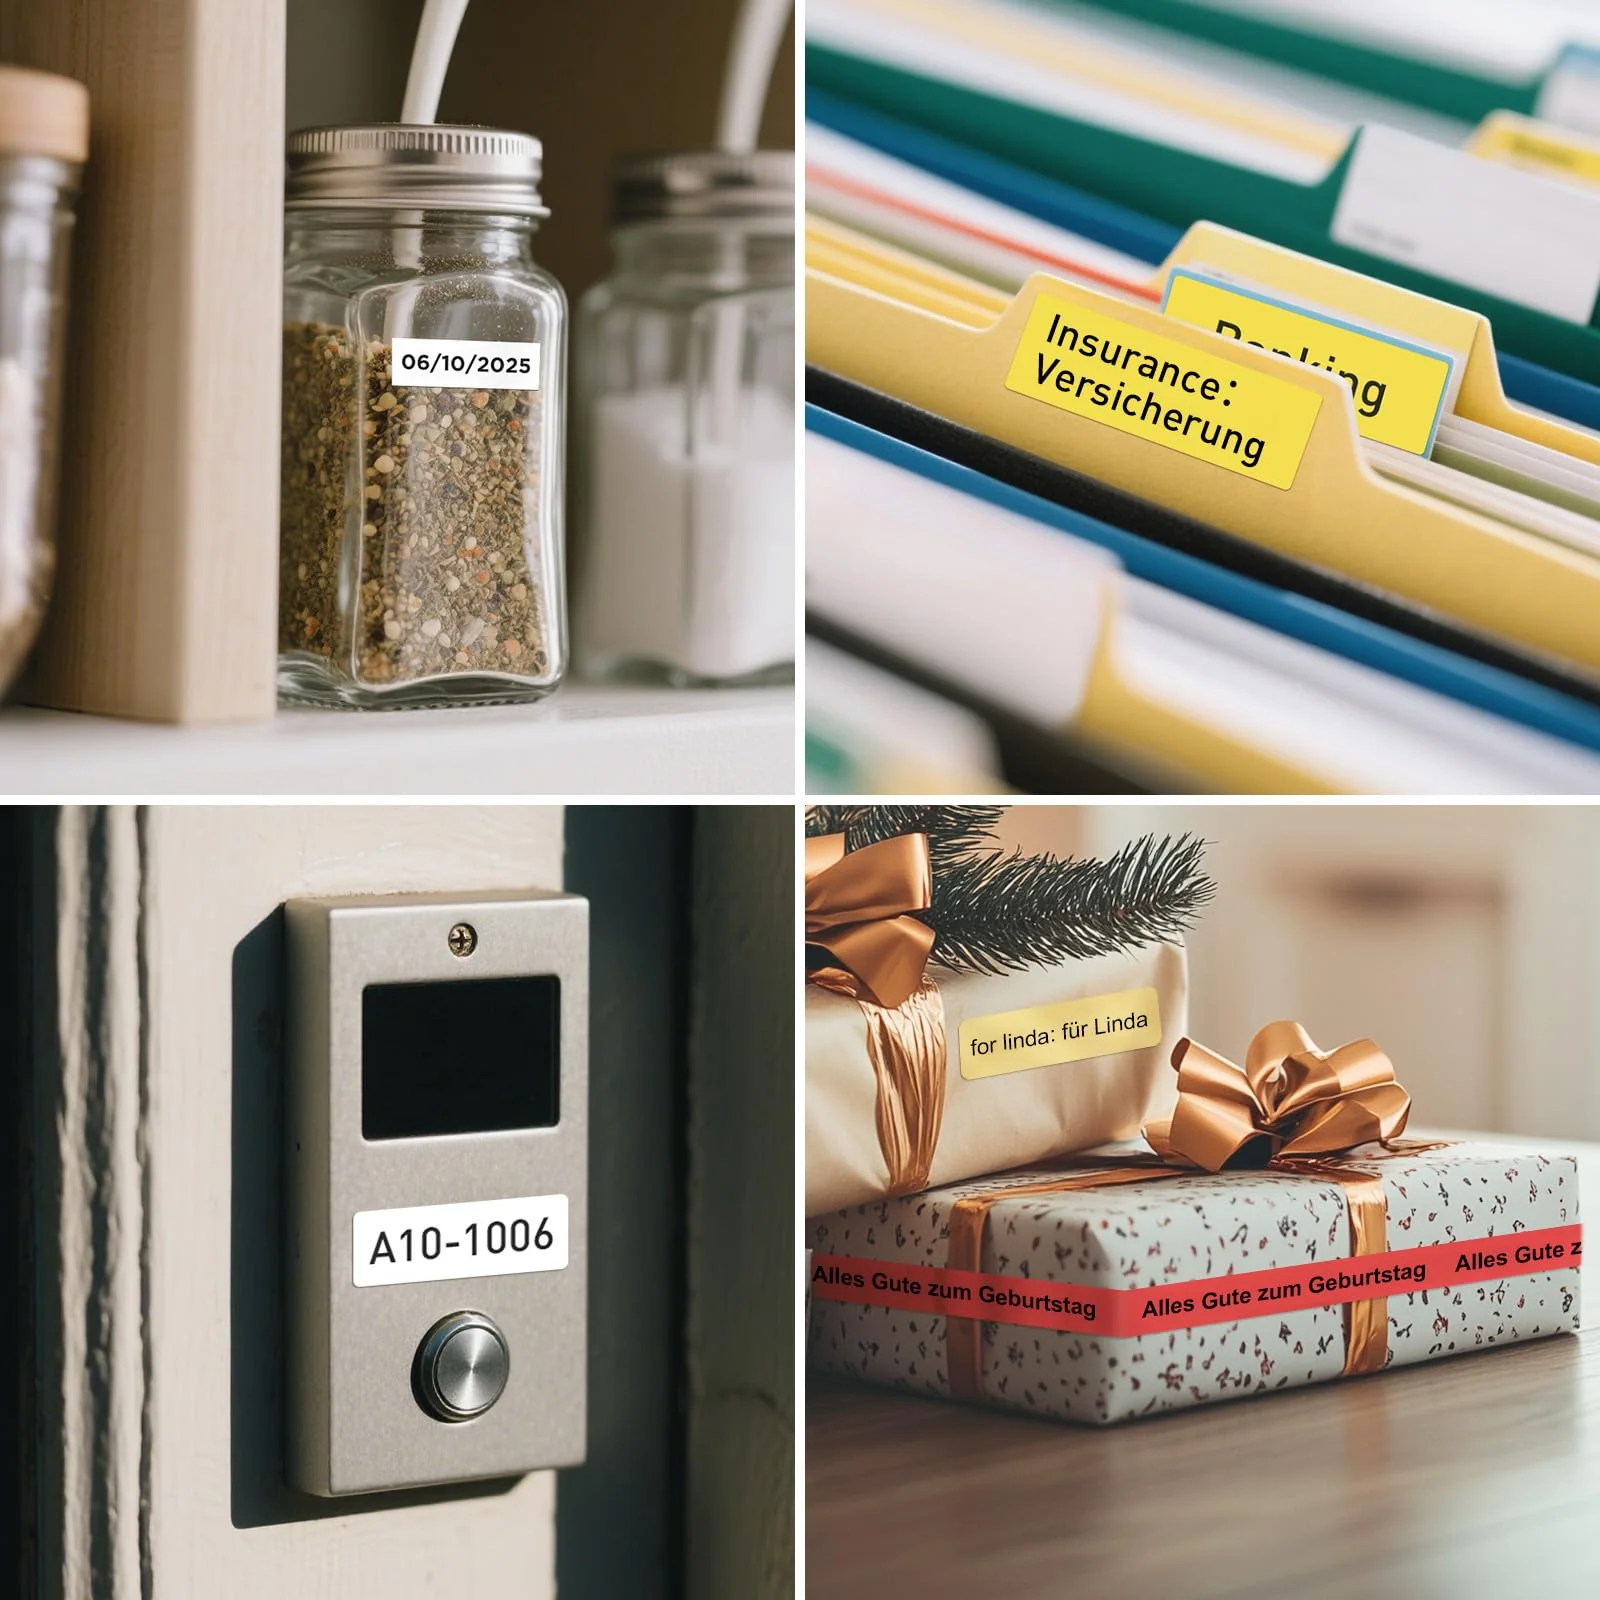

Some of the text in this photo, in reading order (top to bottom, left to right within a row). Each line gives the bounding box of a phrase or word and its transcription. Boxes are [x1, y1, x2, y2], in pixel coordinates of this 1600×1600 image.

[401, 353, 531, 375] 06/10/2025
[1046, 313, 1238, 407] Insurance:
[1037, 352, 1266, 468] Versicherung
[970, 1012, 1148, 1056] for linda: für Linda
[369, 1216, 554, 1265] A10-1006
[1455, 1252, 1508, 1273] Alles
[1515, 1243, 1565, 1264] Gute
[812, 1265, 1096, 1321] Alles Gute zum Geburtstag
[1142, 1263, 1427, 1319] Alles Gute zum Geburtstag
